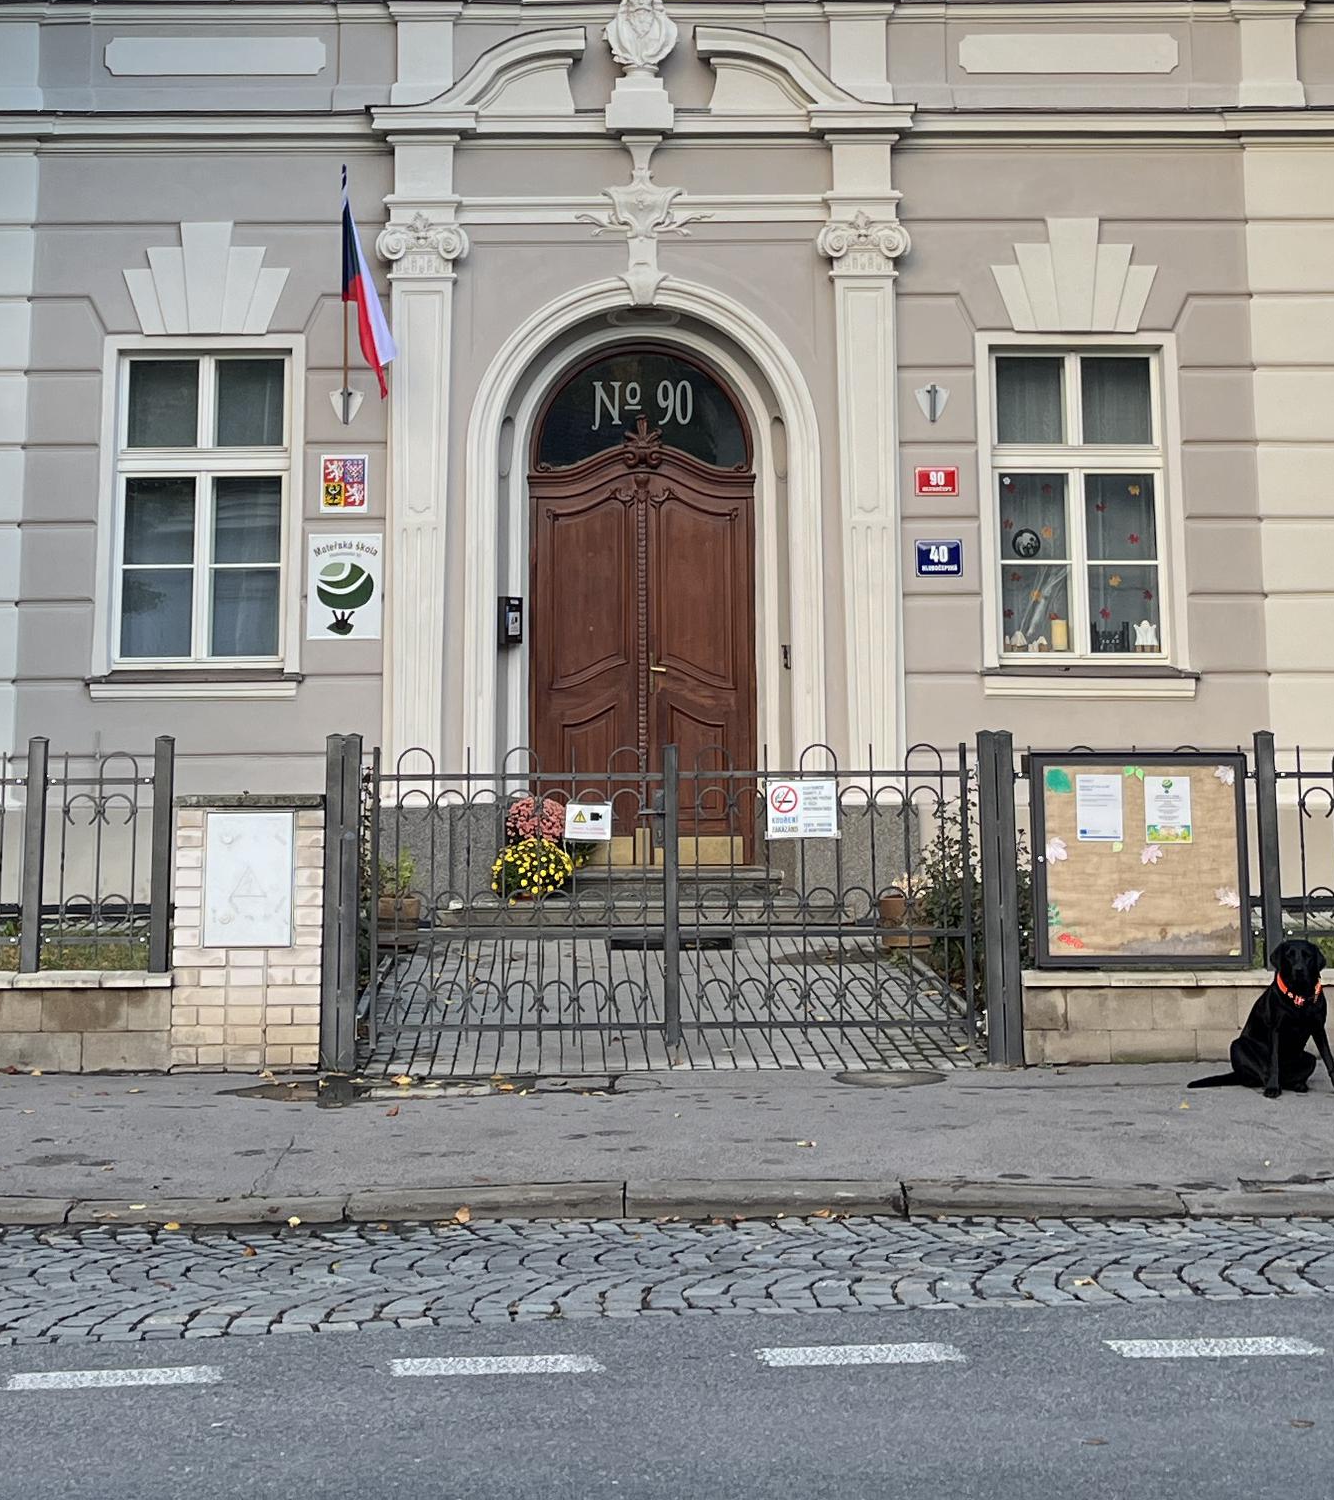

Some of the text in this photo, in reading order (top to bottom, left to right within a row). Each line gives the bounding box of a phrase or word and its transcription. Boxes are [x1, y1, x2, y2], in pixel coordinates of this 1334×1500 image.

[656, 380, 693, 425] 90
[929, 471, 945, 486] 90
[356, 542, 378, 557] škola
[929, 545, 948, 563] 40
